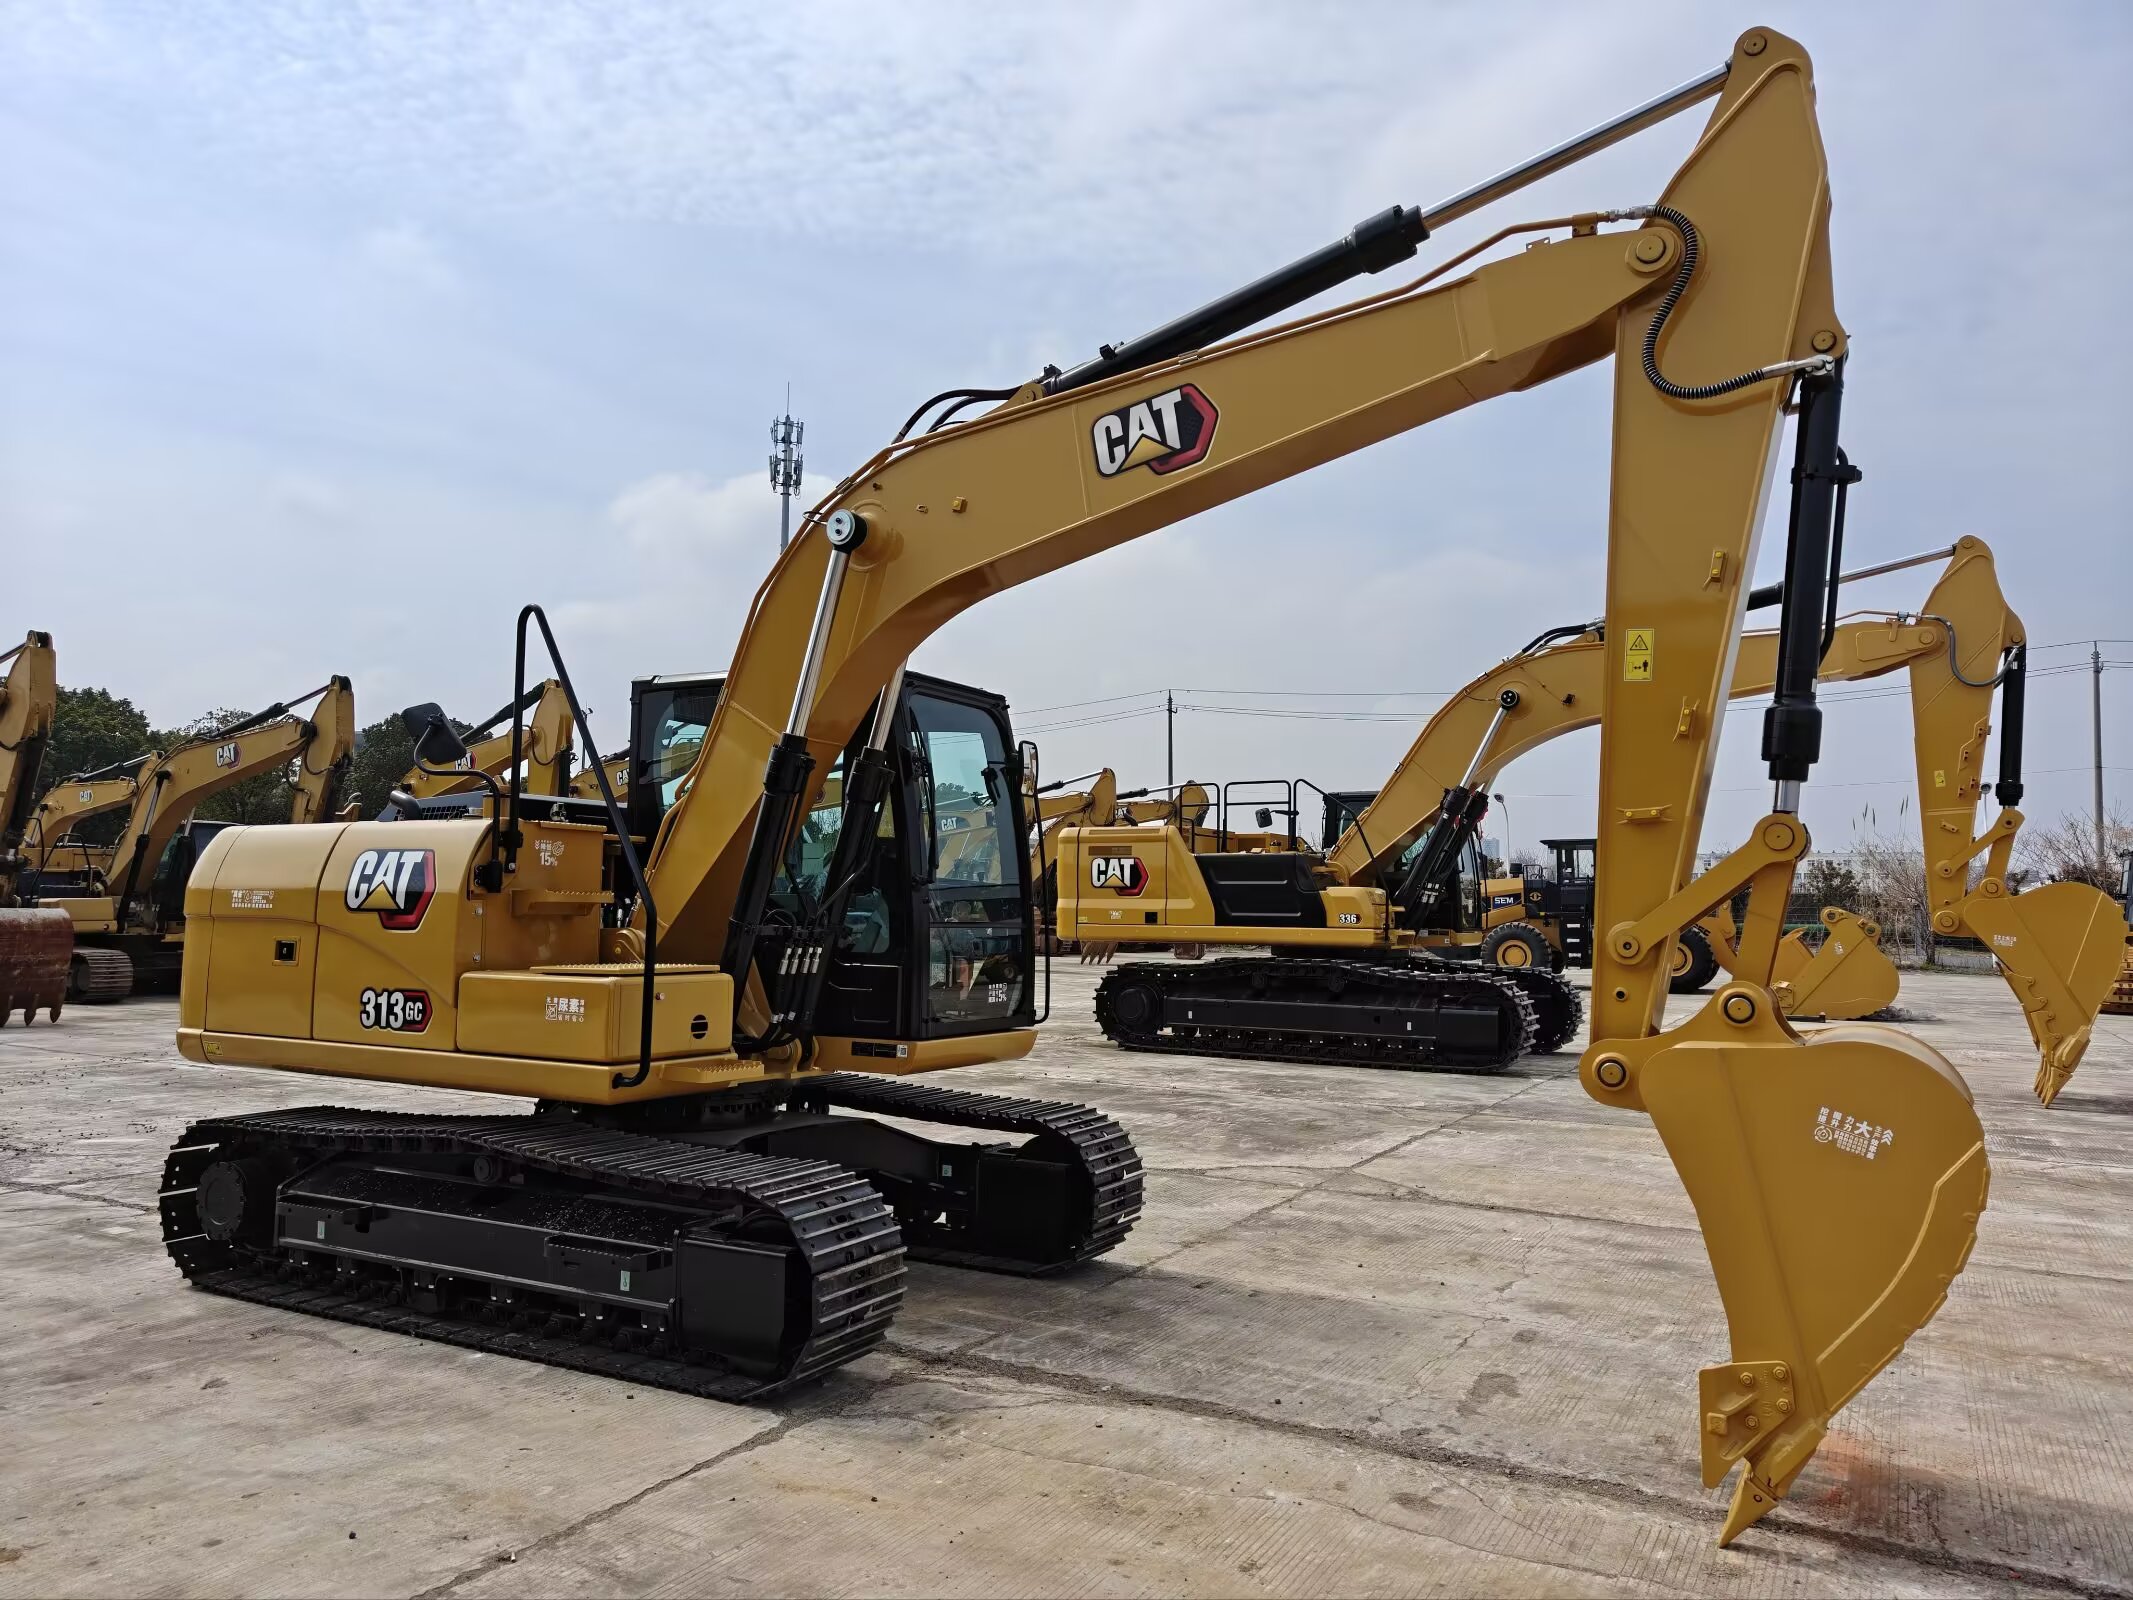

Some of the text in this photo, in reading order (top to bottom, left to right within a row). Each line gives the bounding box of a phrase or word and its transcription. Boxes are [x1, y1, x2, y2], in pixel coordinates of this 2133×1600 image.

[1093, 388, 1182, 475] CAT
[216, 742, 235, 767] CAT
[941, 817, 957, 831] CAT
[346, 850, 425, 910] CAT
[1091, 857, 1135, 888] CAT
[1494, 896, 1514, 905] SEM
[1339, 913, 1357, 924] 336
[361, 989, 423, 1029] 313 GC
